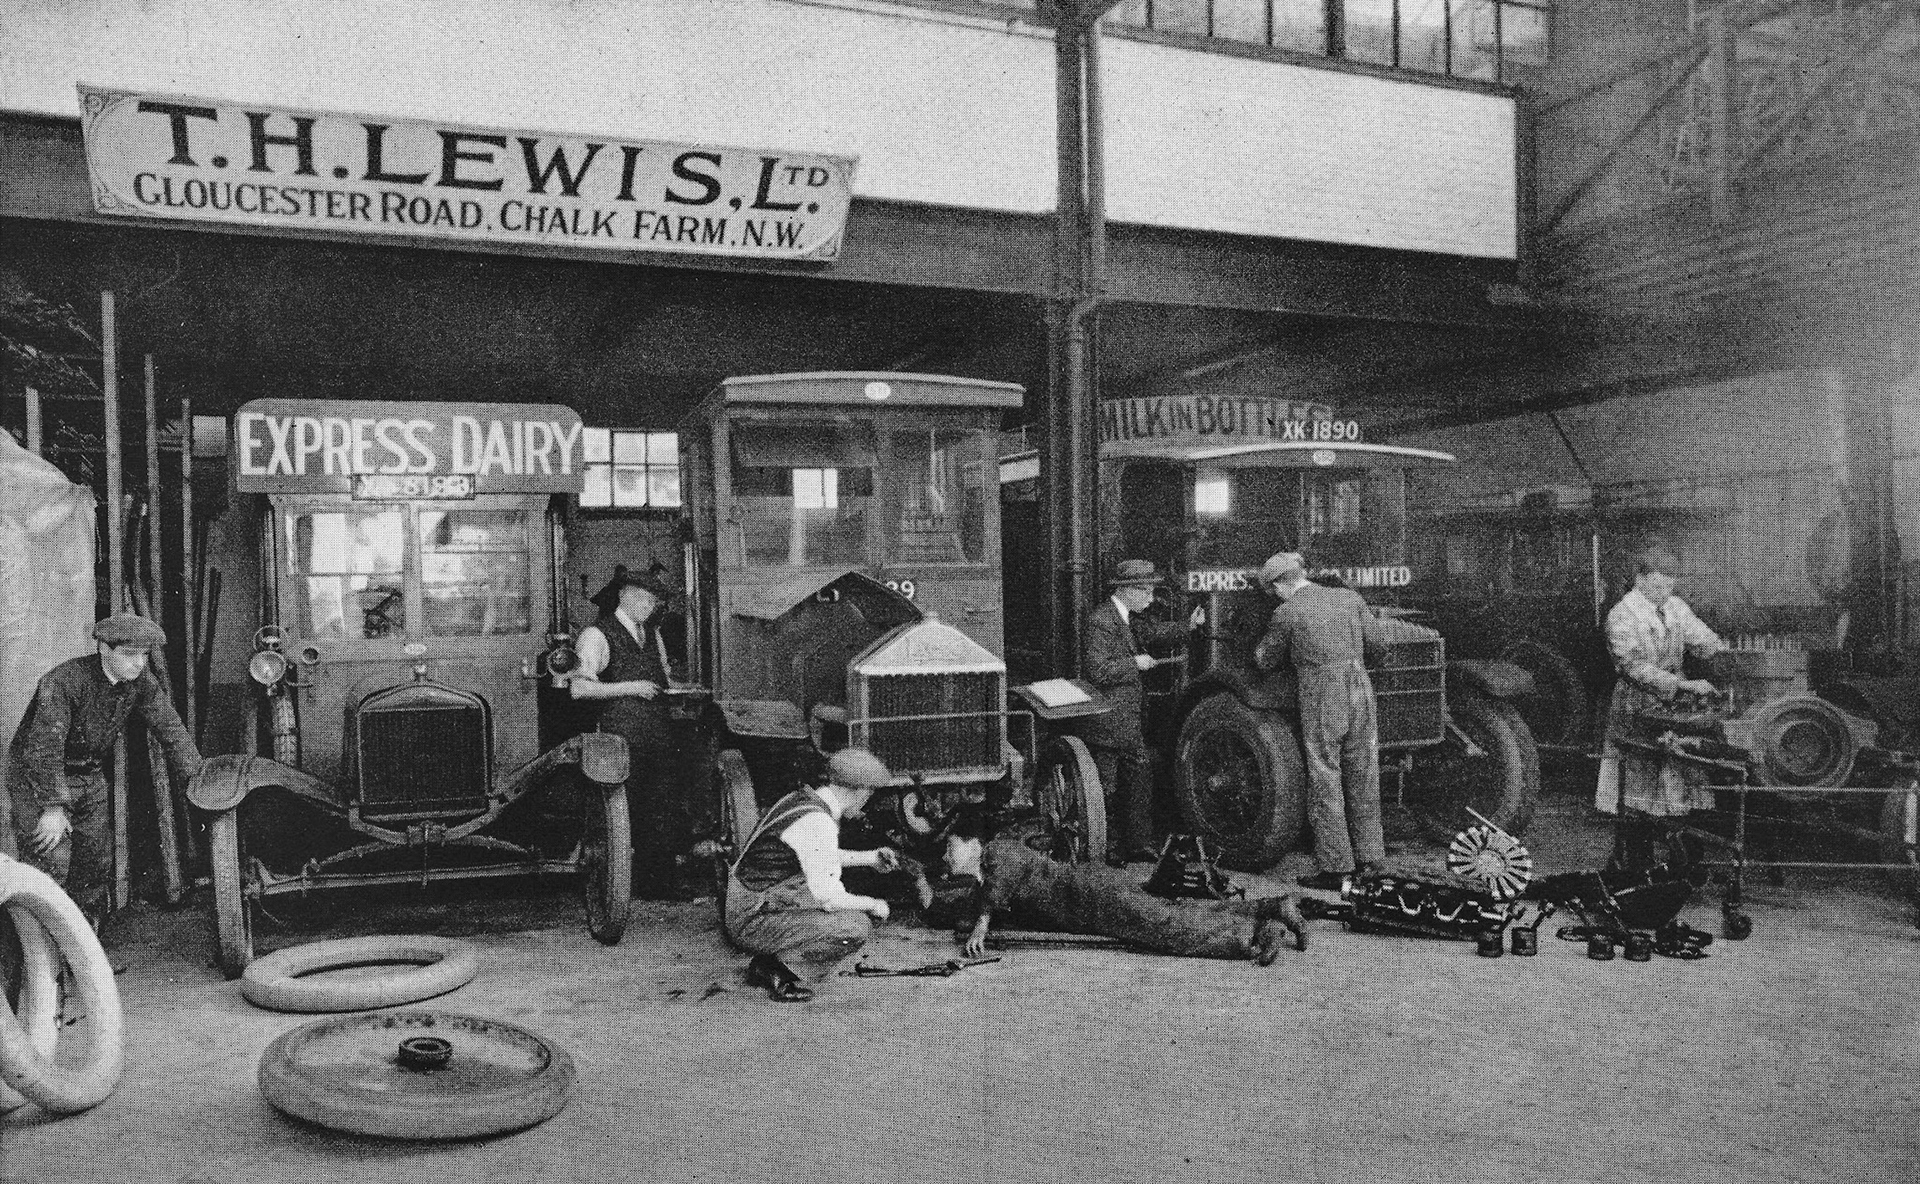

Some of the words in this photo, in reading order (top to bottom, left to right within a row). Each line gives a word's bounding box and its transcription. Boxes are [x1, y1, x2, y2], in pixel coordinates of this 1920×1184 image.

[133, 172, 373, 221] GLOUCESTER
[500, 200, 618, 238] CHALK
[240, 411, 437, 476] EXPRESS
[452, 415, 584, 476] DAIRY
[1099, 398, 1168, 442] MILK
[1170, 402, 1193, 432] IN
